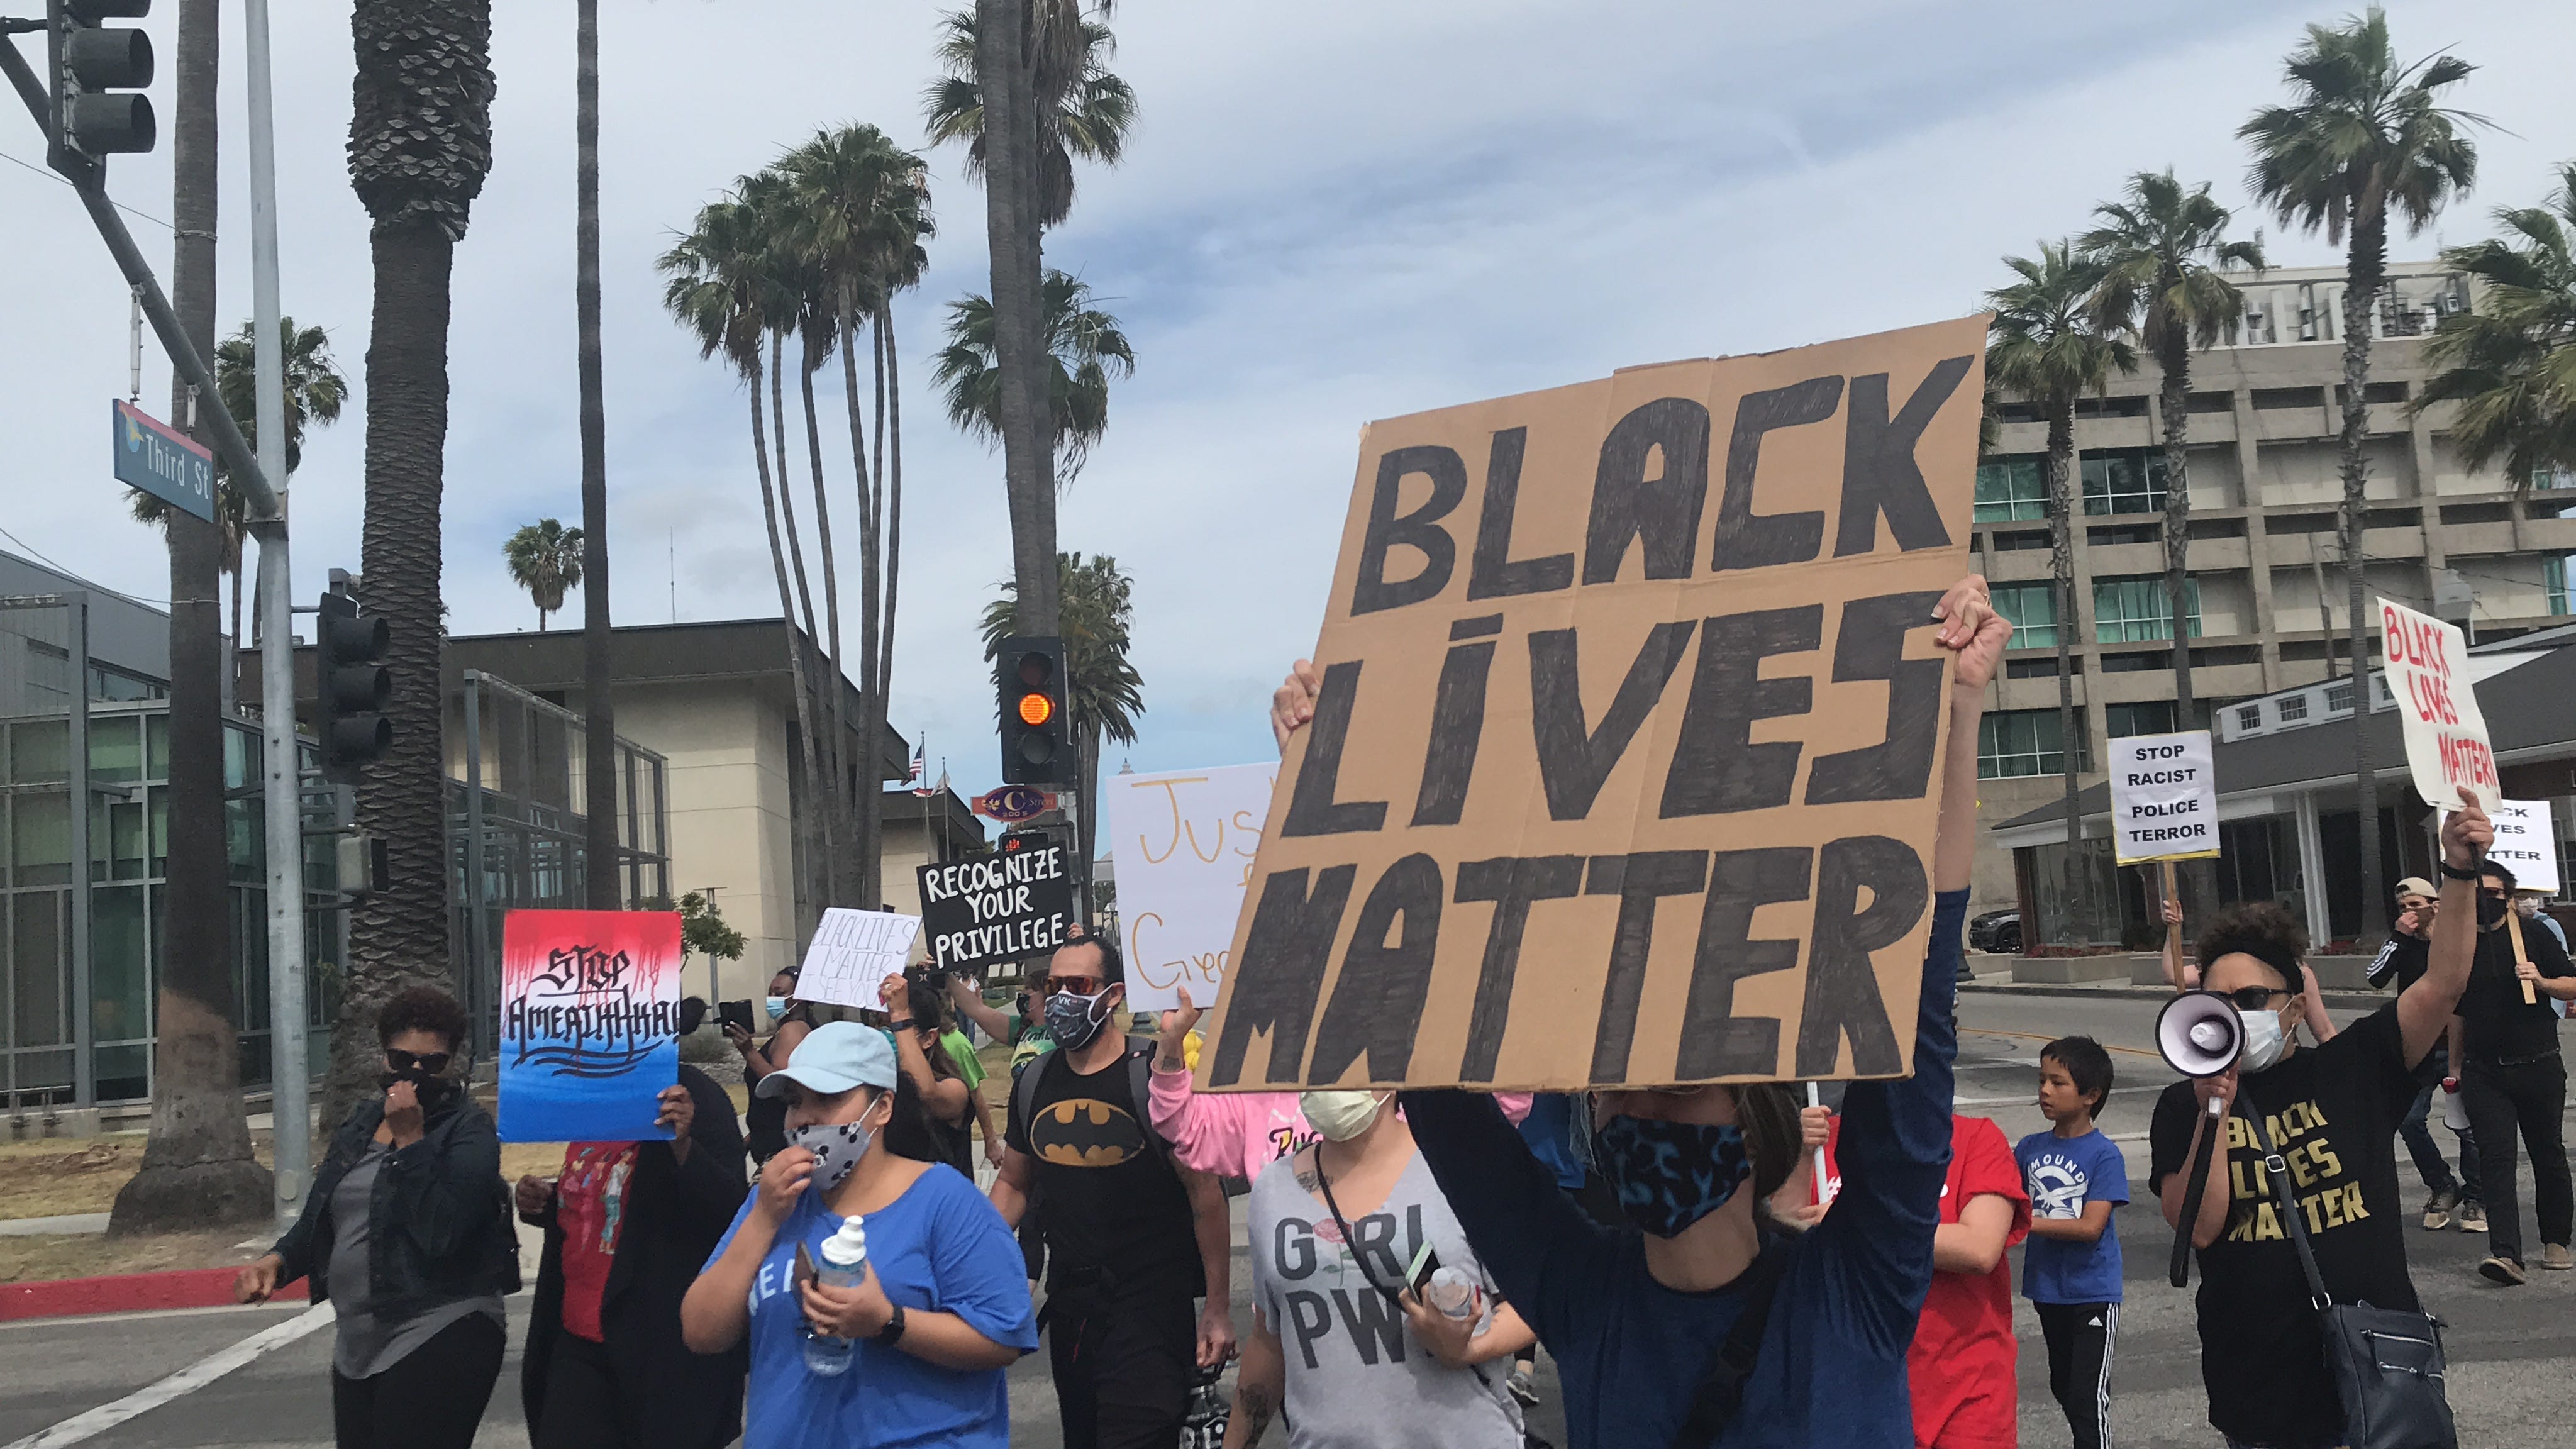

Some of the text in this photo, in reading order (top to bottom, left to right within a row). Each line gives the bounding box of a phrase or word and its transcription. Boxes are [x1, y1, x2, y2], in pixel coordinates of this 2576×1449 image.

[146, 433, 209, 499] Third St
[1350, 354, 1975, 618] BLACK
[2384, 606, 2451, 679] BLACK
[2407, 670, 2458, 725] LIVES
[2136, 745, 2185, 761] STOP
[1004, 791, 1054, 811] C Street
[2128, 769, 2197, 786] RACIST
[2131, 799, 2199, 818] POLICE
[2129, 824, 2206, 843] TERROR
[925, 847, 1062, 903] RECOGNIZE
[964, 885, 1035, 924] YOUR
[812, 911, 916, 955] BLACK LIVES
[935, 912, 1064, 970] PRIVILEGE
[820, 948, 892, 982] MATTER
[1209, 835, 1928, 1088] MATTER
[2226, 1099, 2328, 1152] BLACK
[2031, 1153, 2085, 1183] MOUND
[2231, 1137, 2342, 1200] LIES
